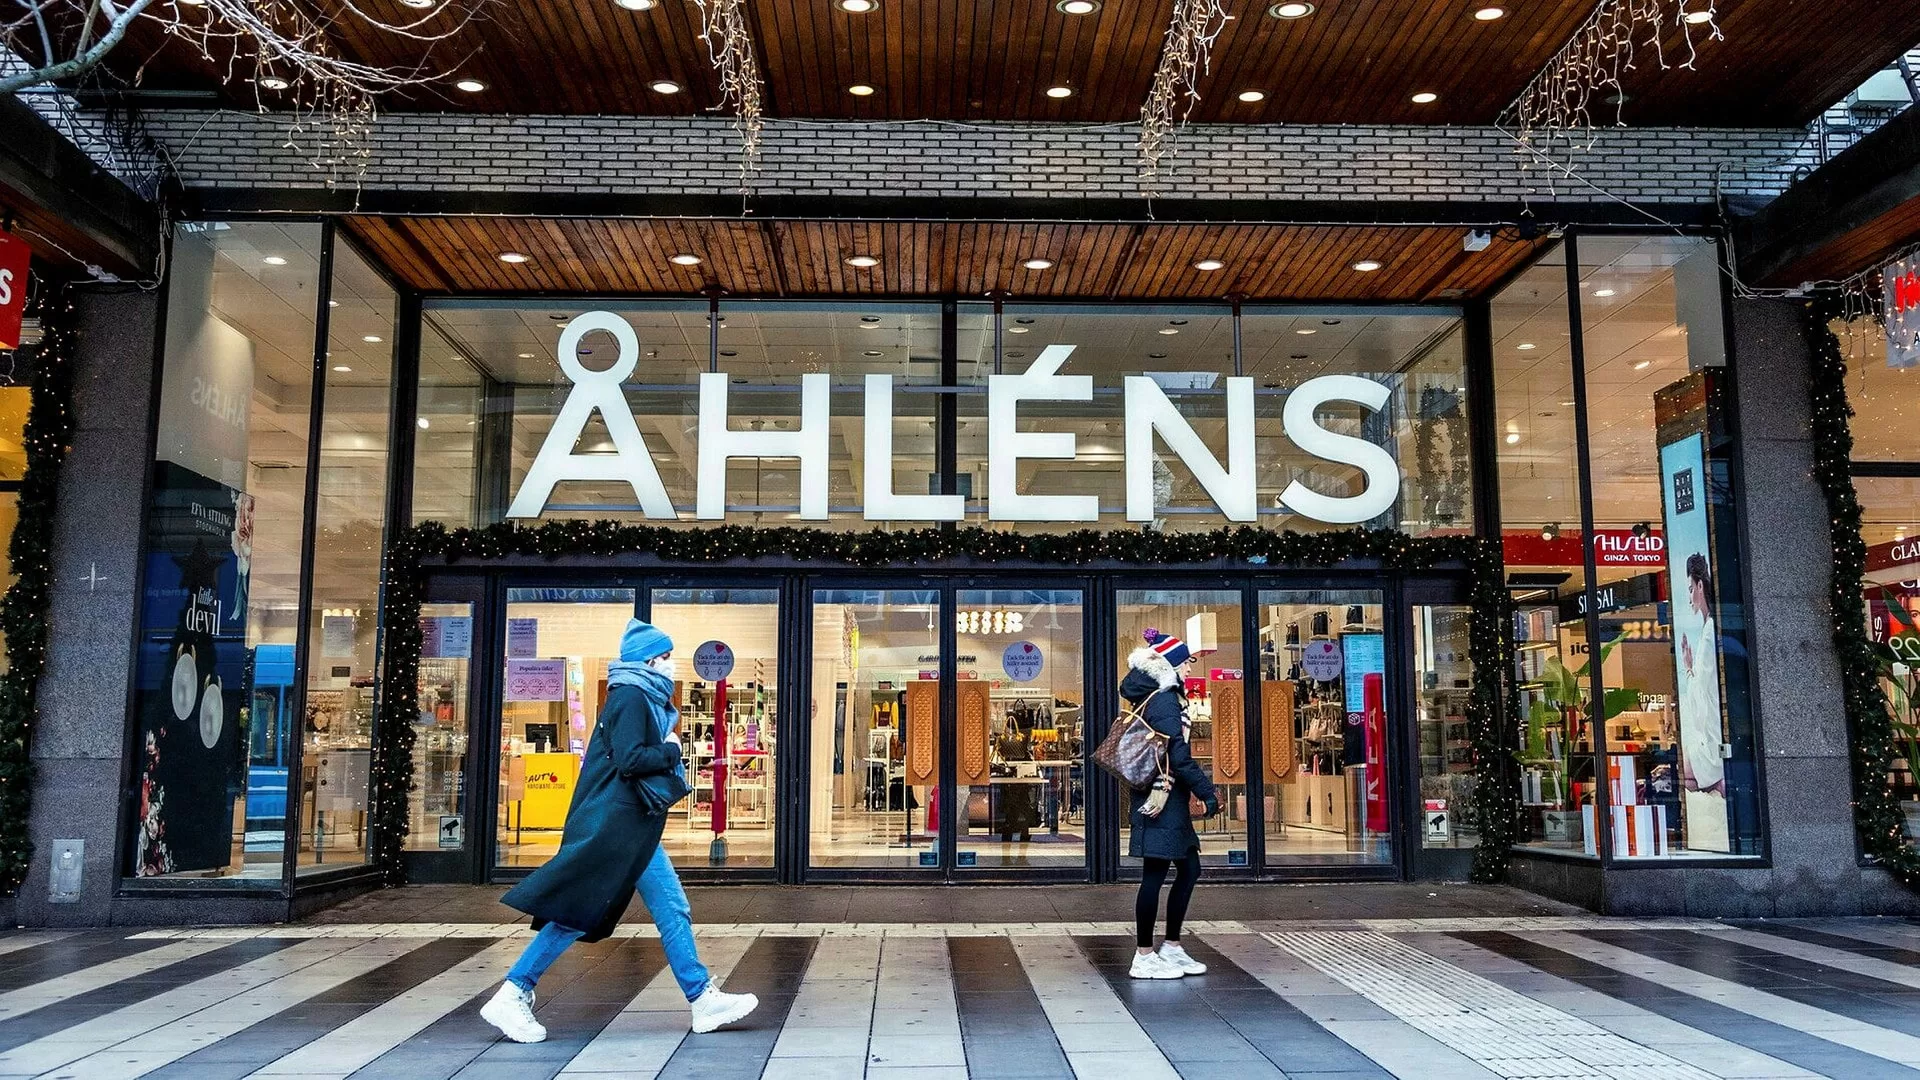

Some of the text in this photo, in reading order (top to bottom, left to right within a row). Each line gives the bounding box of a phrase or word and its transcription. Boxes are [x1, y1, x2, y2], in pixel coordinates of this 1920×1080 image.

[506, 310, 1400, 523] ÅHLÉNS
[1594, 534, 1664, 551] SHISEID
[1604, 554, 1661, 562] GINZA TOKYO
[186, 593, 222, 636] devil
